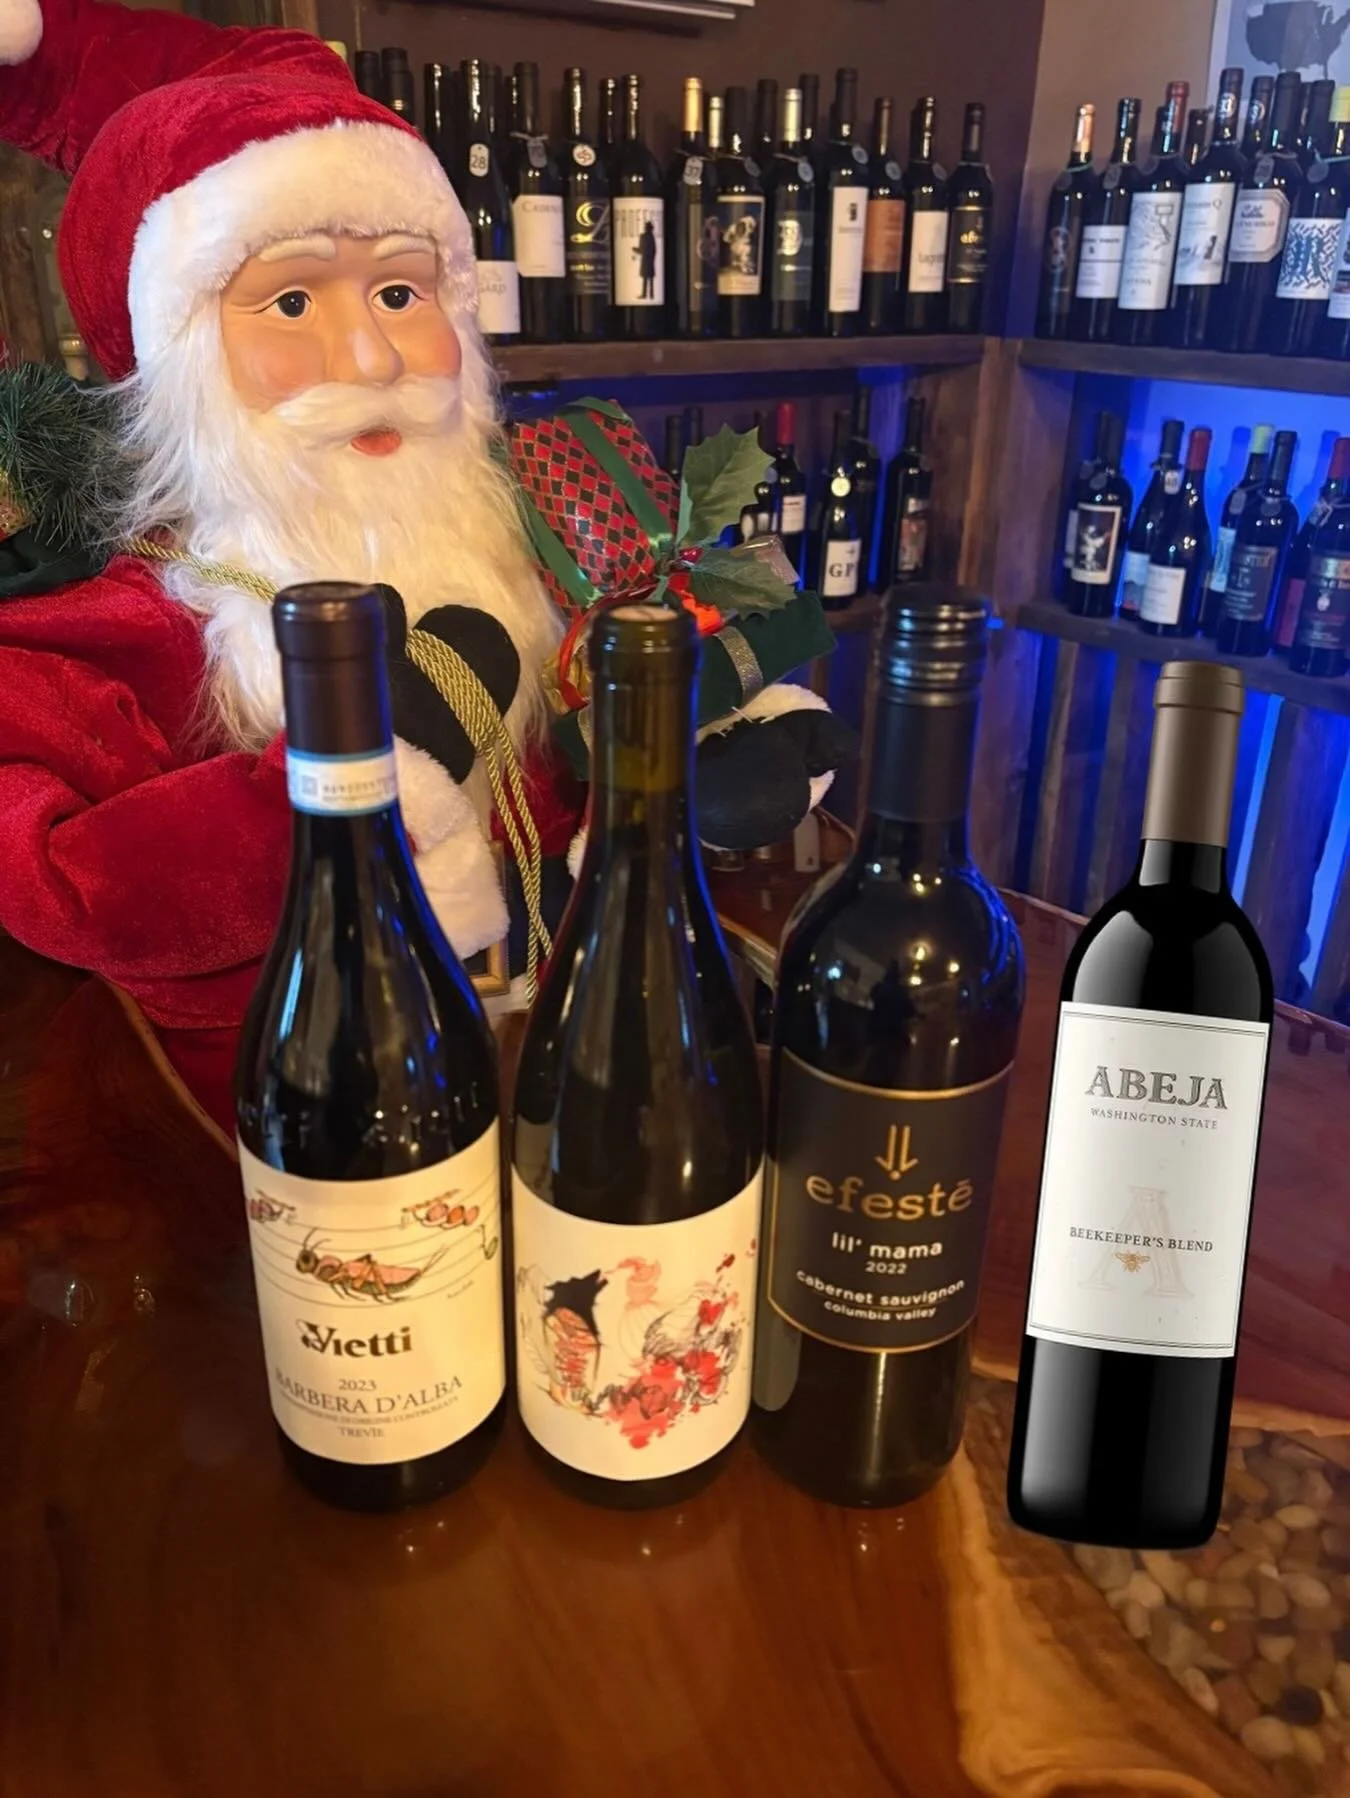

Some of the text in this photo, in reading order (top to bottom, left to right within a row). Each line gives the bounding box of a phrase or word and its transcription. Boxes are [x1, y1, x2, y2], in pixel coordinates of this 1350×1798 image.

[471, 156, 486, 169] 28
[1085, 1065, 1228, 1110] ABEJA
[1091, 1107, 1218, 1130] WASHINGTON STATE
[869, 1241, 943, 1260] mama
[1070, 1227, 1213, 1252] BEEKEEPER'S BLEND
[865, 1261, 908, 1275] 2022
[796, 1270, 965, 1306] cabernet sauvignon
[824, 1300, 938, 1321] columbia valley
[296, 1318, 412, 1358] Vietti
[275, 1367, 368, 1414] BARBERA
[376, 1376, 462, 1413] D'ALBA
[338, 1379, 378, 1392] 2023
